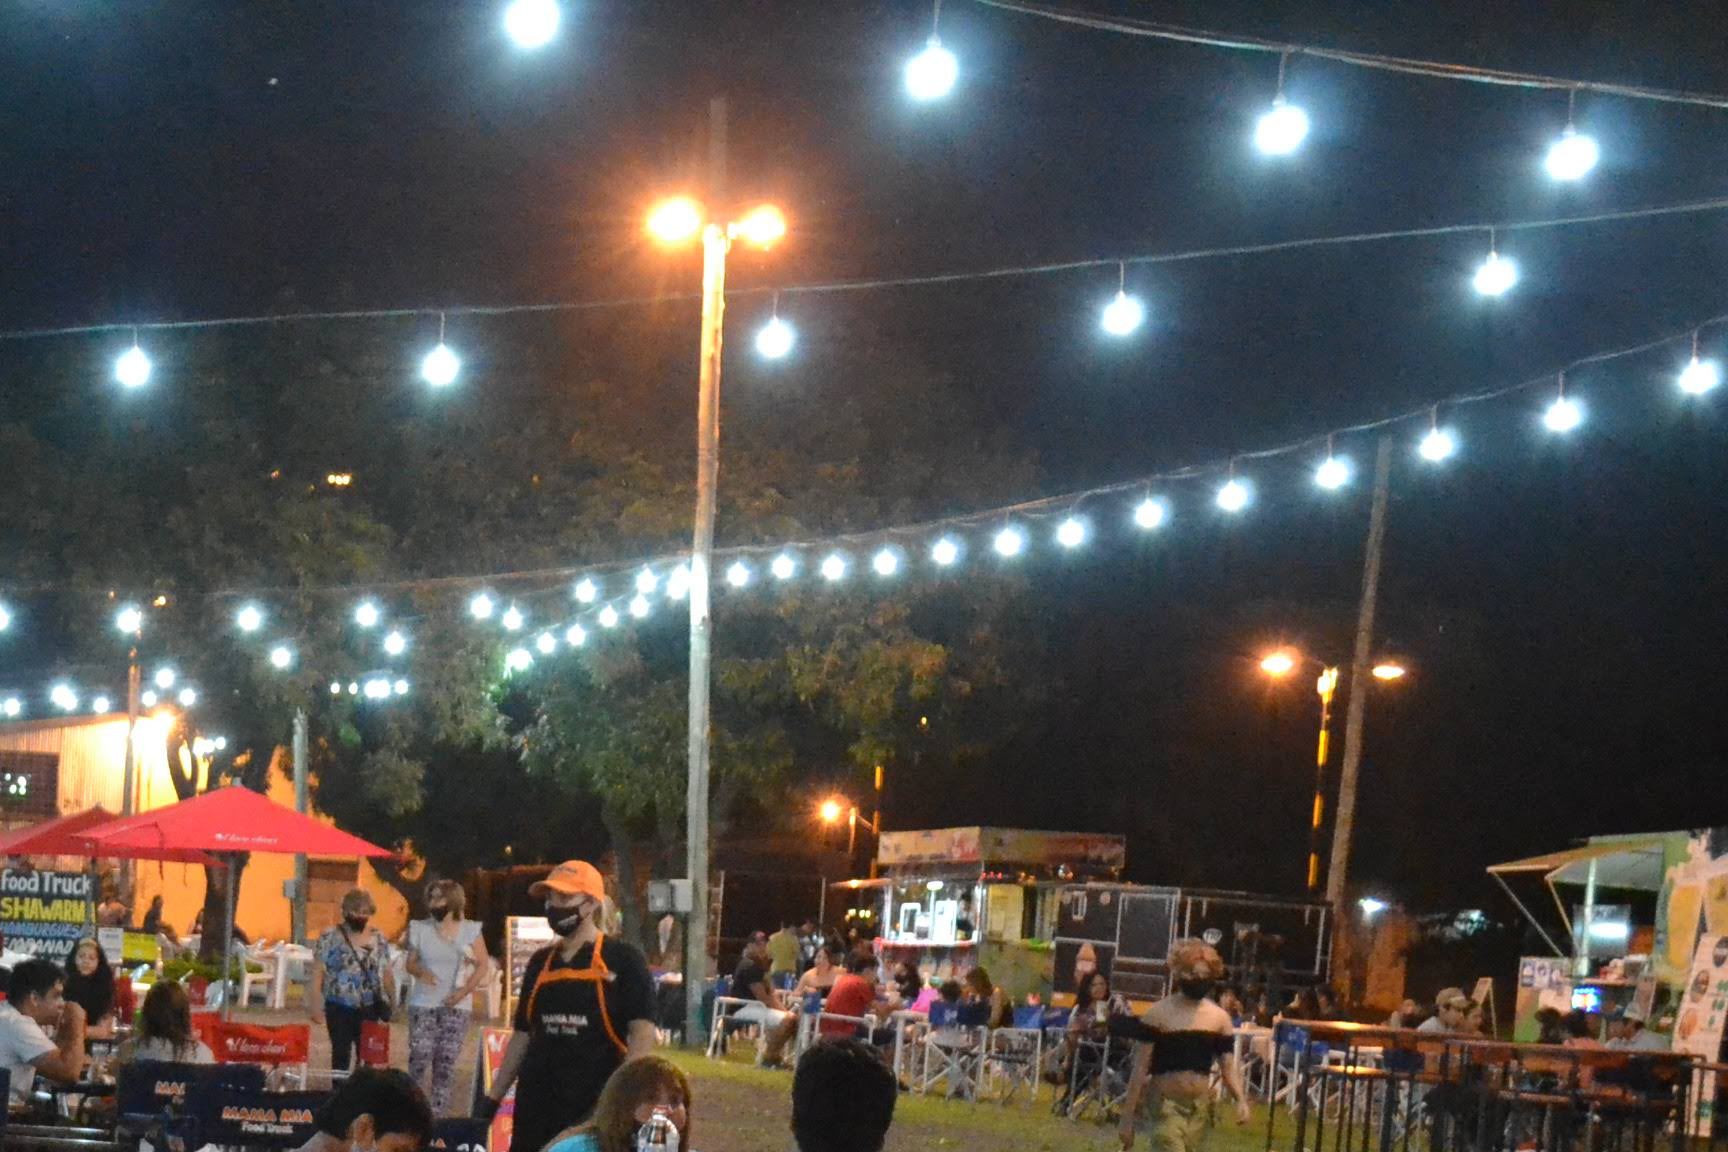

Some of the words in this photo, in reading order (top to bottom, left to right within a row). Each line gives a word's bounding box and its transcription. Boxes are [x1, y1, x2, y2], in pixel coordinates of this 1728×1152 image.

[43, 872, 91, 895] Truck
[222, 1105, 277, 1122] MAMA
[279, 1107, 313, 1124] MIA
